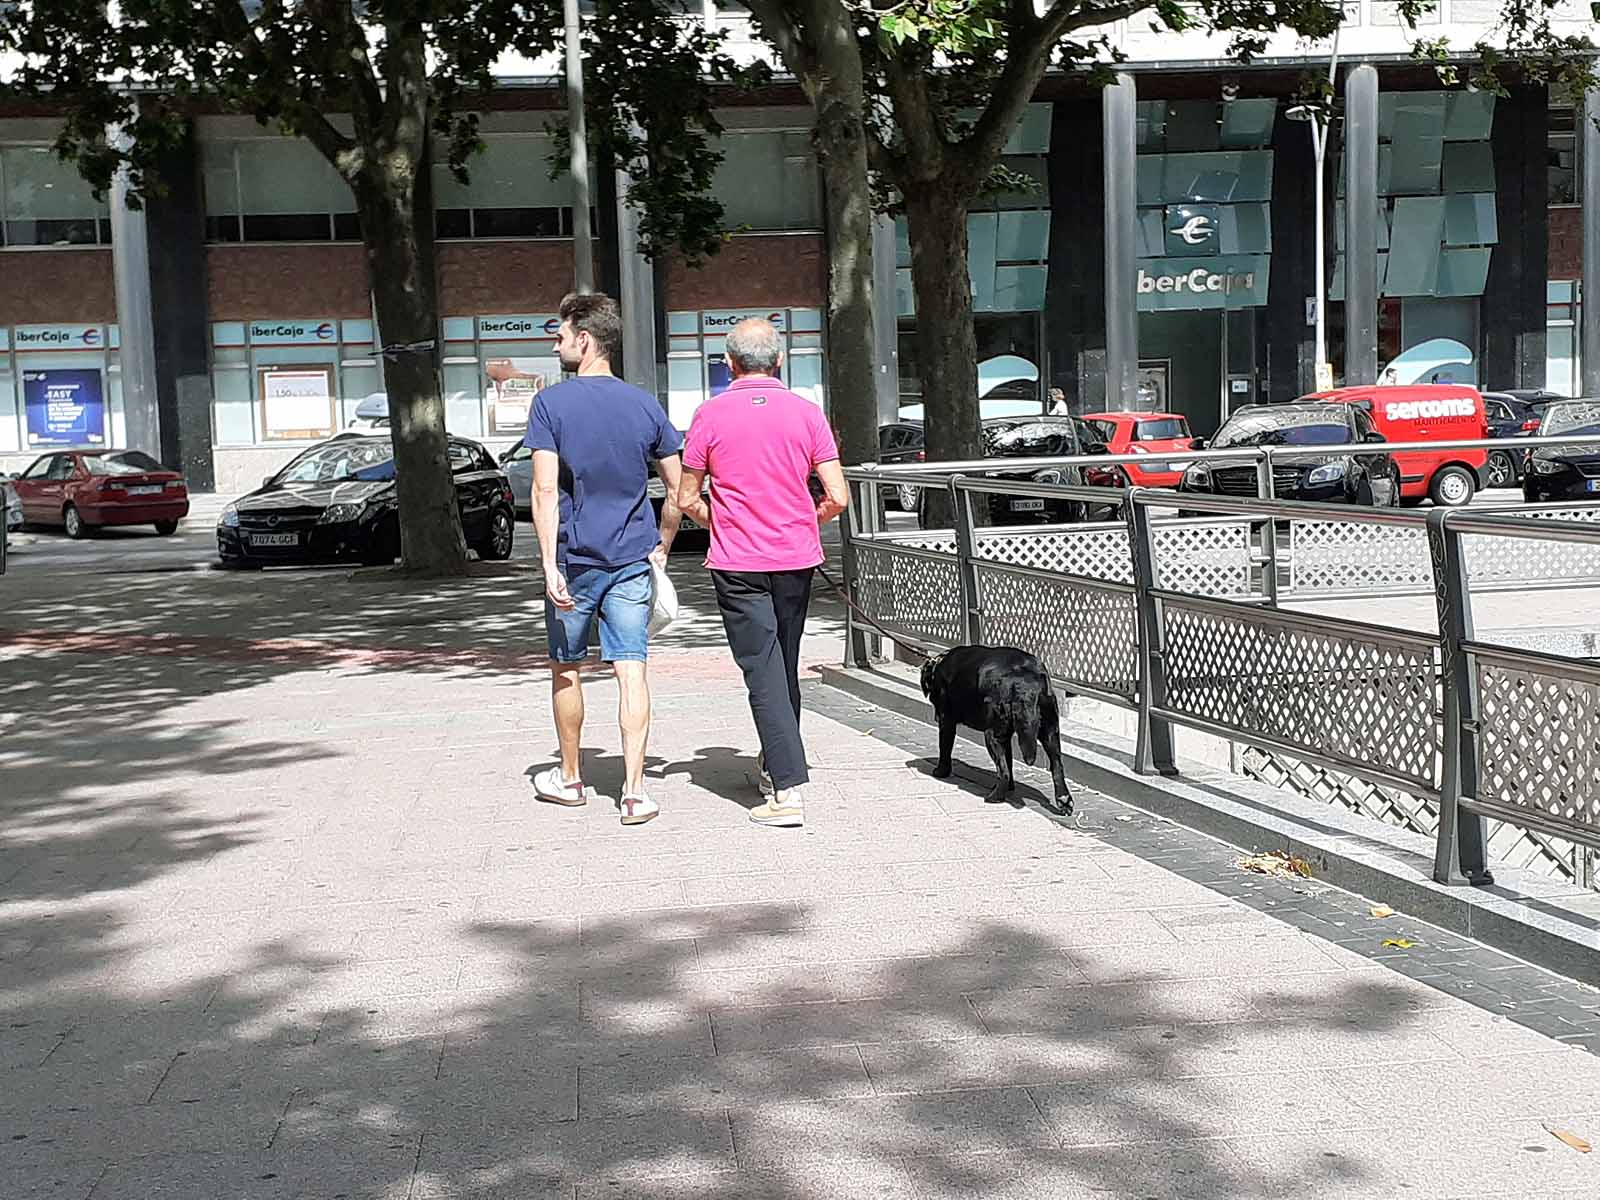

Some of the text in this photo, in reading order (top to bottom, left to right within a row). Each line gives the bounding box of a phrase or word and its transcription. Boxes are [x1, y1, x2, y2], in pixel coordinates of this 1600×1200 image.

[1136, 267, 1254, 296] berCaja
[480, 320, 532, 333] iberCaja
[705, 315, 747, 326] iberC
[16, 331, 70, 343] iberCaja
[252, 325, 304, 338] iberCaja
[1385, 398, 1476, 421] sercoms
